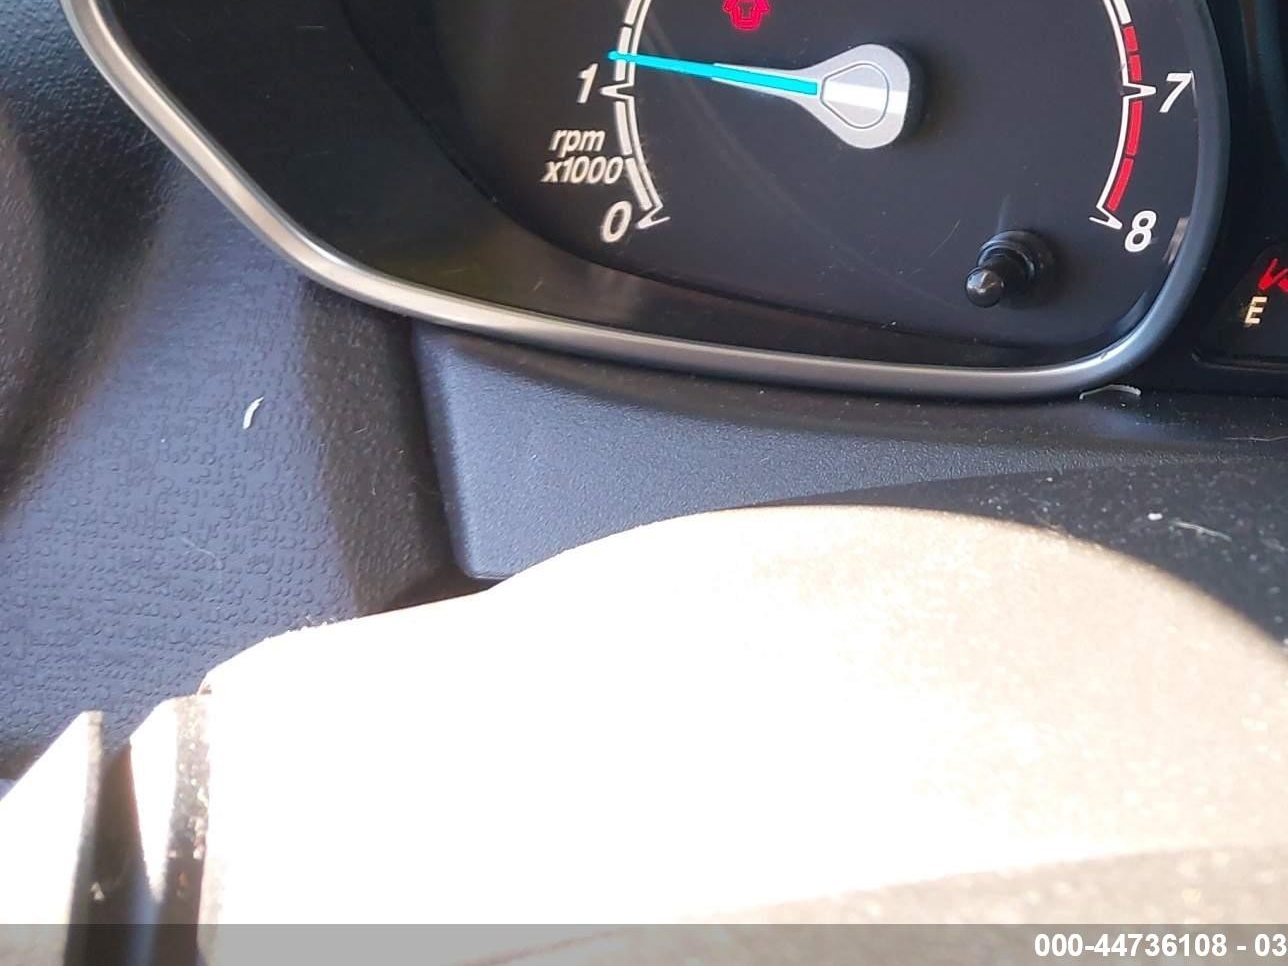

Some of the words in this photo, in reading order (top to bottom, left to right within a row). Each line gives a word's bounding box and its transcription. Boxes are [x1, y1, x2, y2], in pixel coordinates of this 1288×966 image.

[577, 63, 599, 104] 1
[1159, 70, 1194, 114] 7
[549, 129, 606, 158] rpm
[541, 155, 624, 185] x1000
[600, 202, 634, 243] 0
[1124, 210, 1157, 253] 8
[1244, 296, 1268, 325] E
